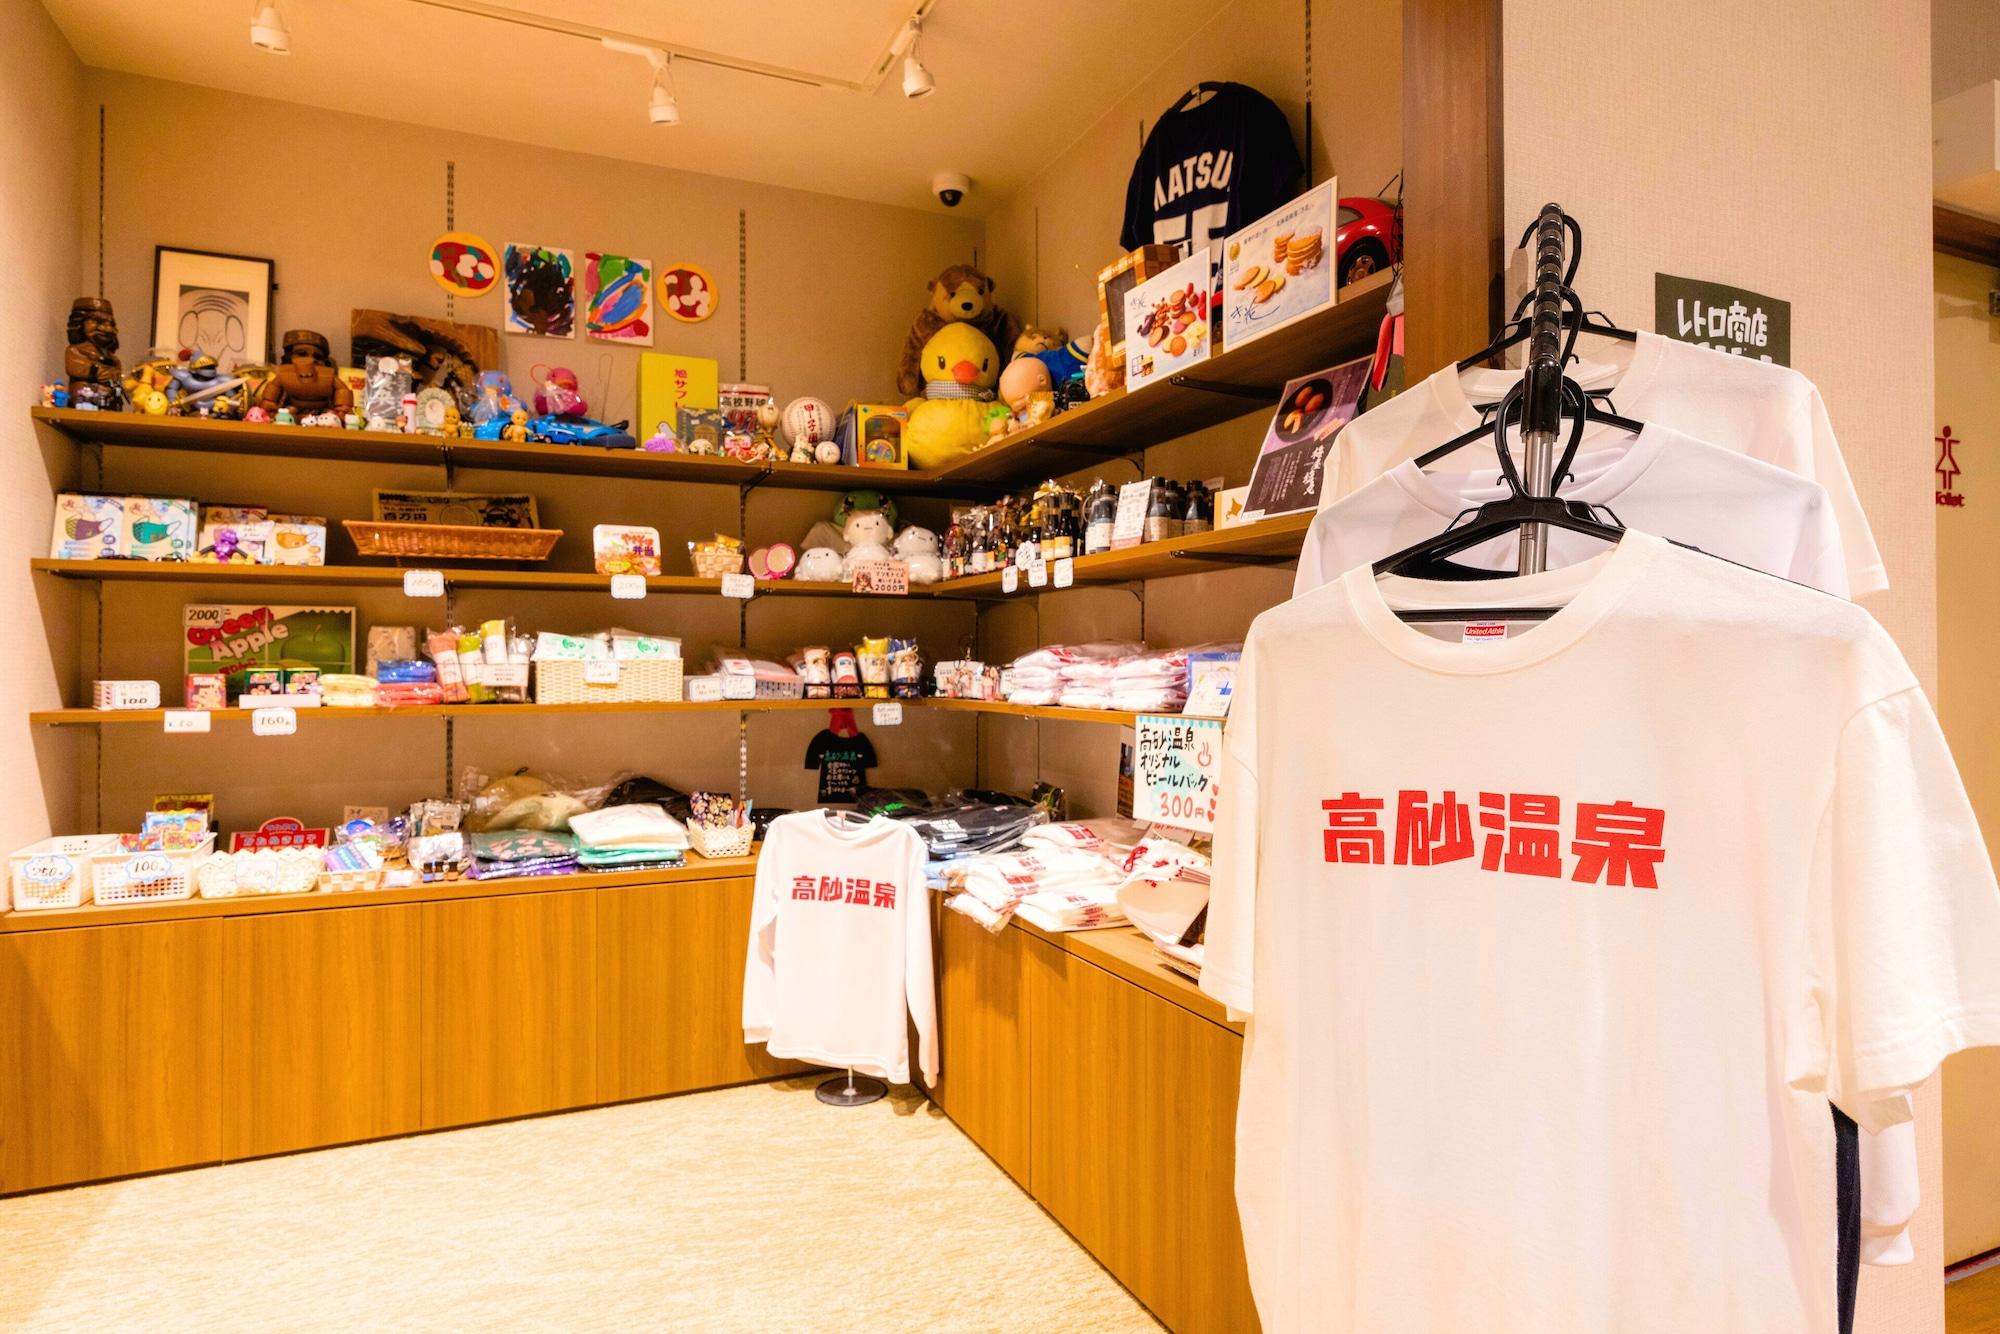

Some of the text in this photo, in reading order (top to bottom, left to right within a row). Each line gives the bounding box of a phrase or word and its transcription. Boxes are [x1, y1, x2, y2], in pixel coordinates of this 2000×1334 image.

[1677, 298, 1768, 347] レトロ商店
[210, 623, 289, 662] Apple
[1140, 725, 1196, 752] 高砂温泉
[1140, 752, 1181, 770] オリジナル
[1161, 792, 1205, 819] 300円
[1321, 789, 1666, 889] 高砂温泉
[791, 876, 897, 910] 高砂温泉
